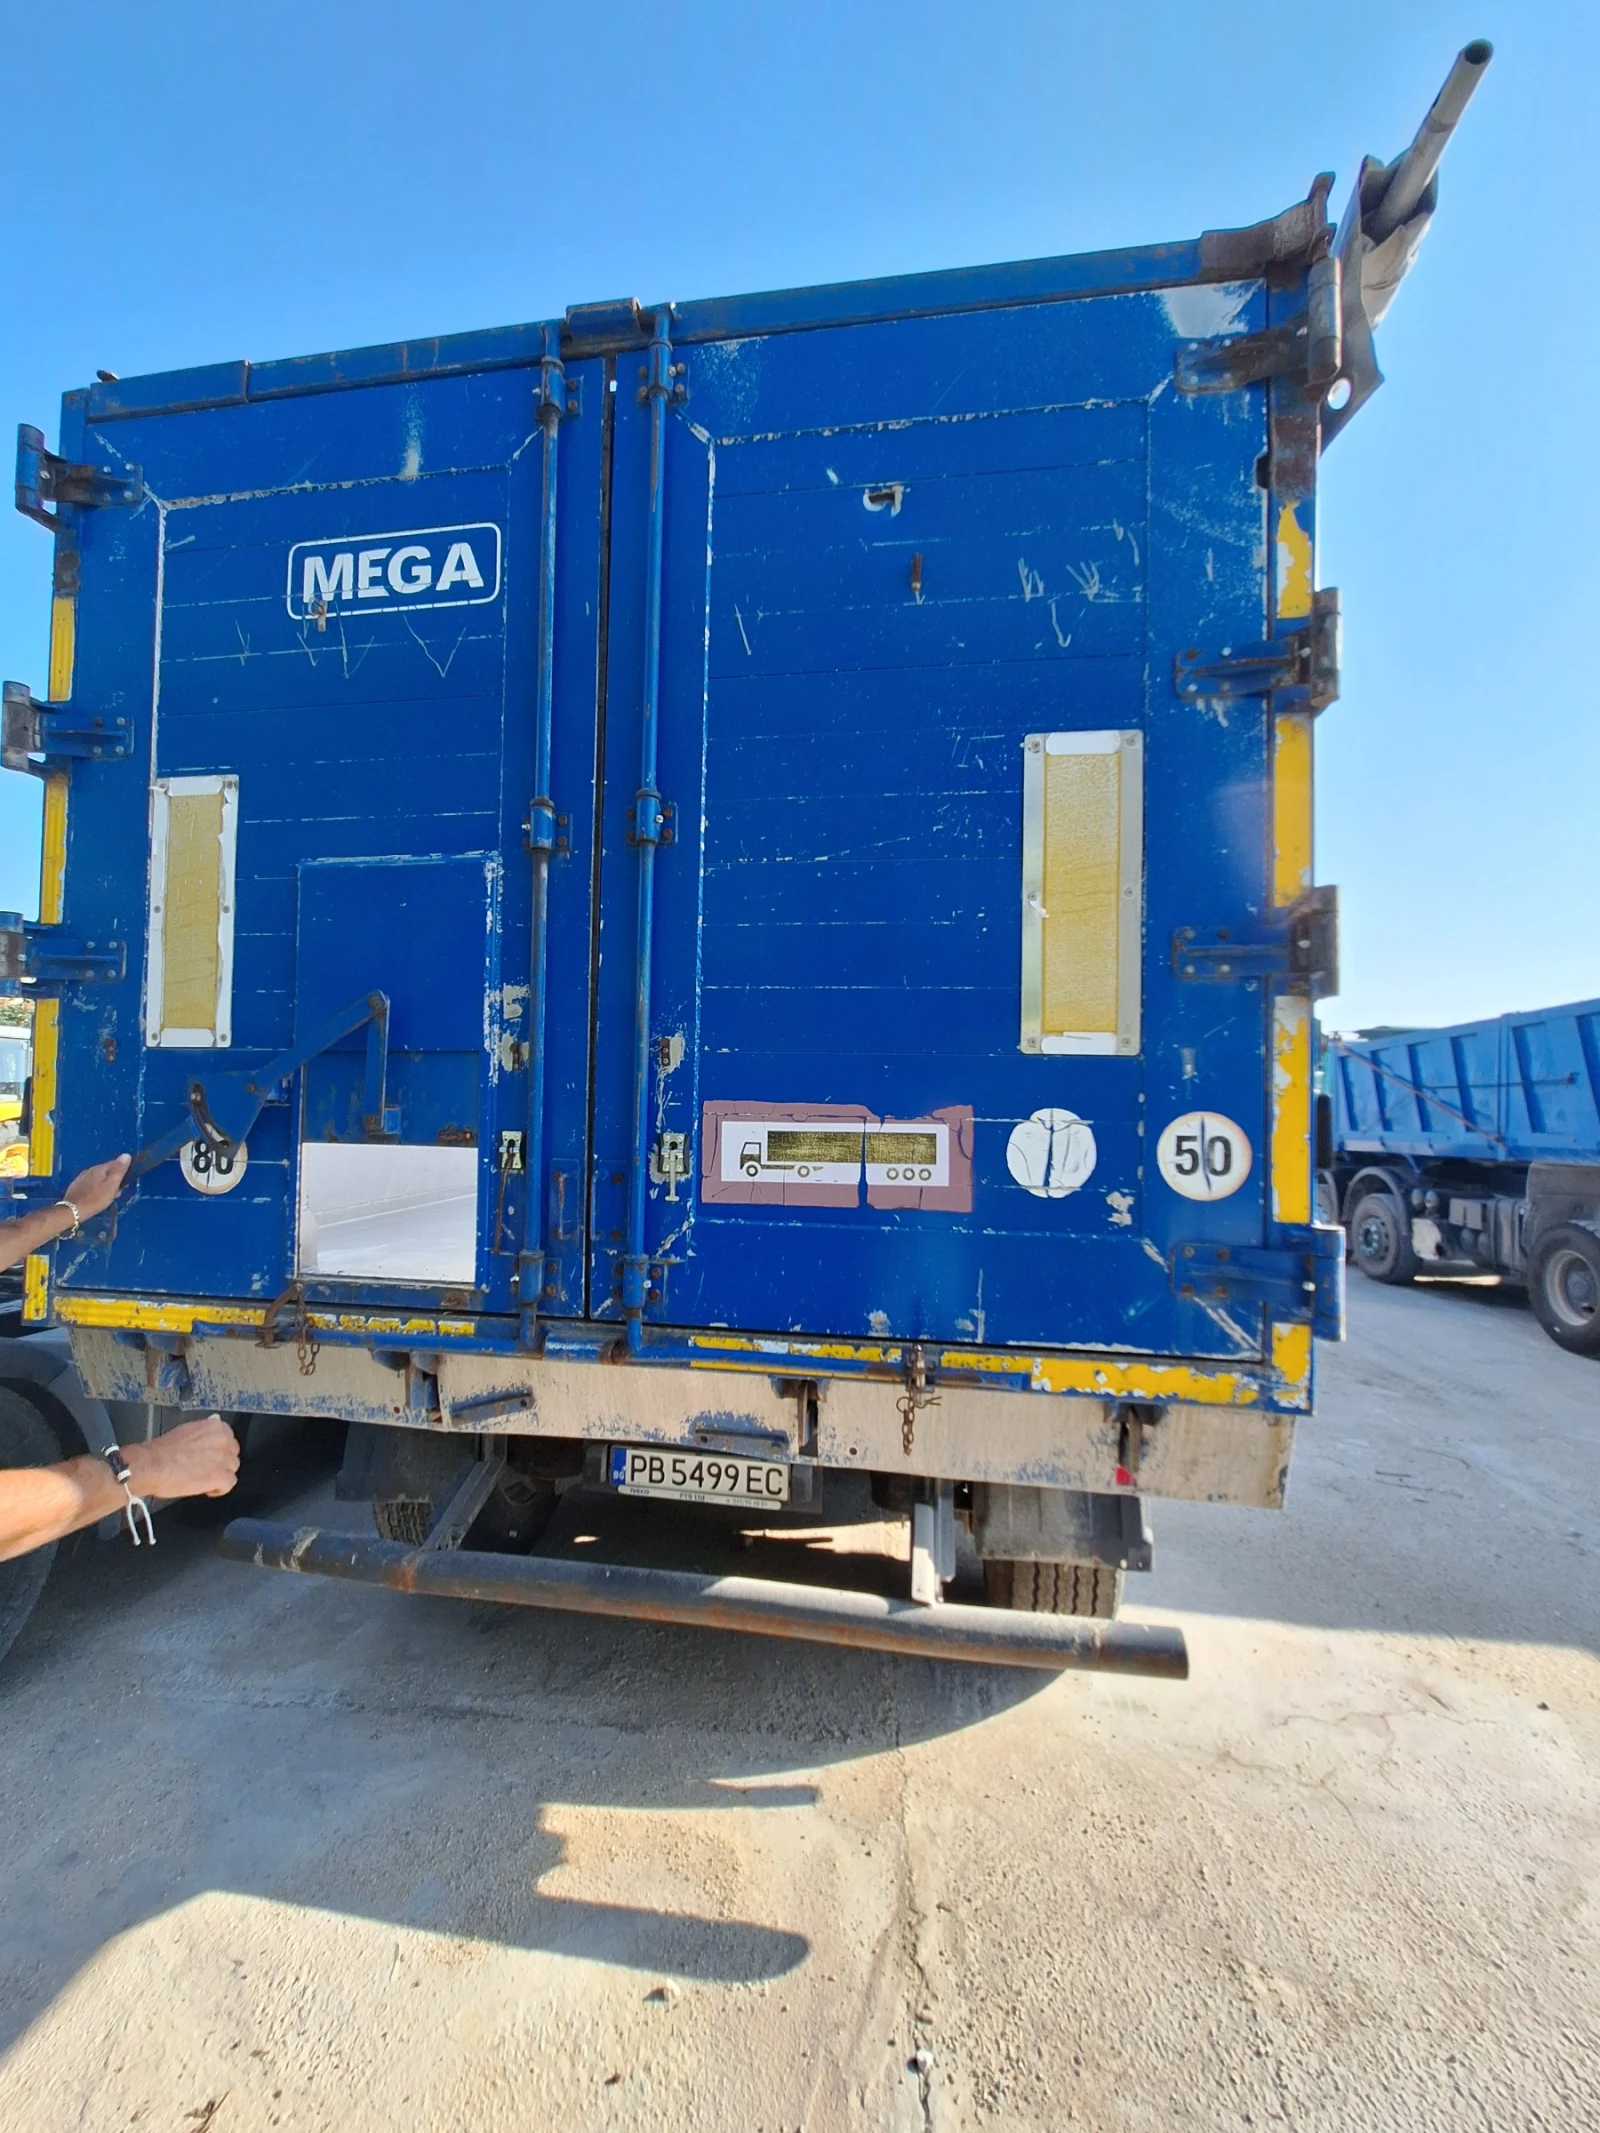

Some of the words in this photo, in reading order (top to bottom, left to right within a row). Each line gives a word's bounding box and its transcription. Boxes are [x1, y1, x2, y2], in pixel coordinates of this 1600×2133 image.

[303, 542, 485, 603] MEGA
[1175, 1135, 1232, 1176] 50
[612, 1470, 625, 1480] BG
